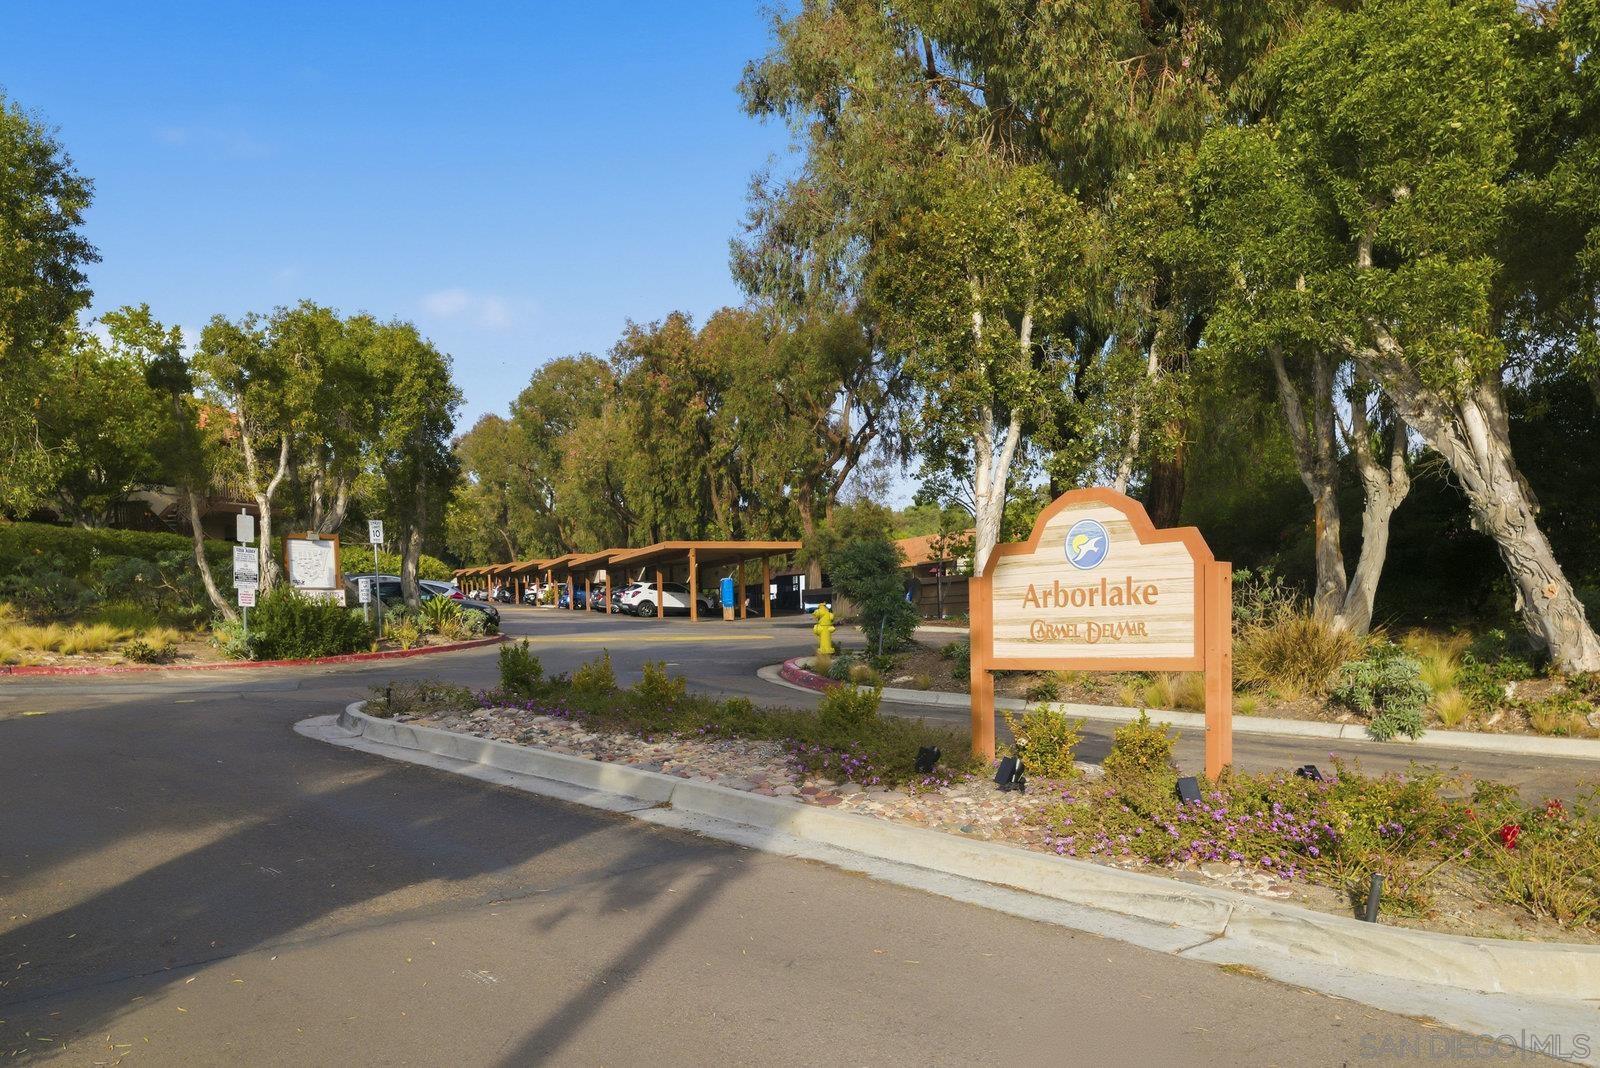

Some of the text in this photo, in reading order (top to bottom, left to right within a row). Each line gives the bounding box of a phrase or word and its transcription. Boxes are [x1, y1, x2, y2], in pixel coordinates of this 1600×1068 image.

[372, 529, 381, 538] 10
[1022, 575, 1159, 609] Arborlake
[1029, 619, 1081, 643] CARMEL
